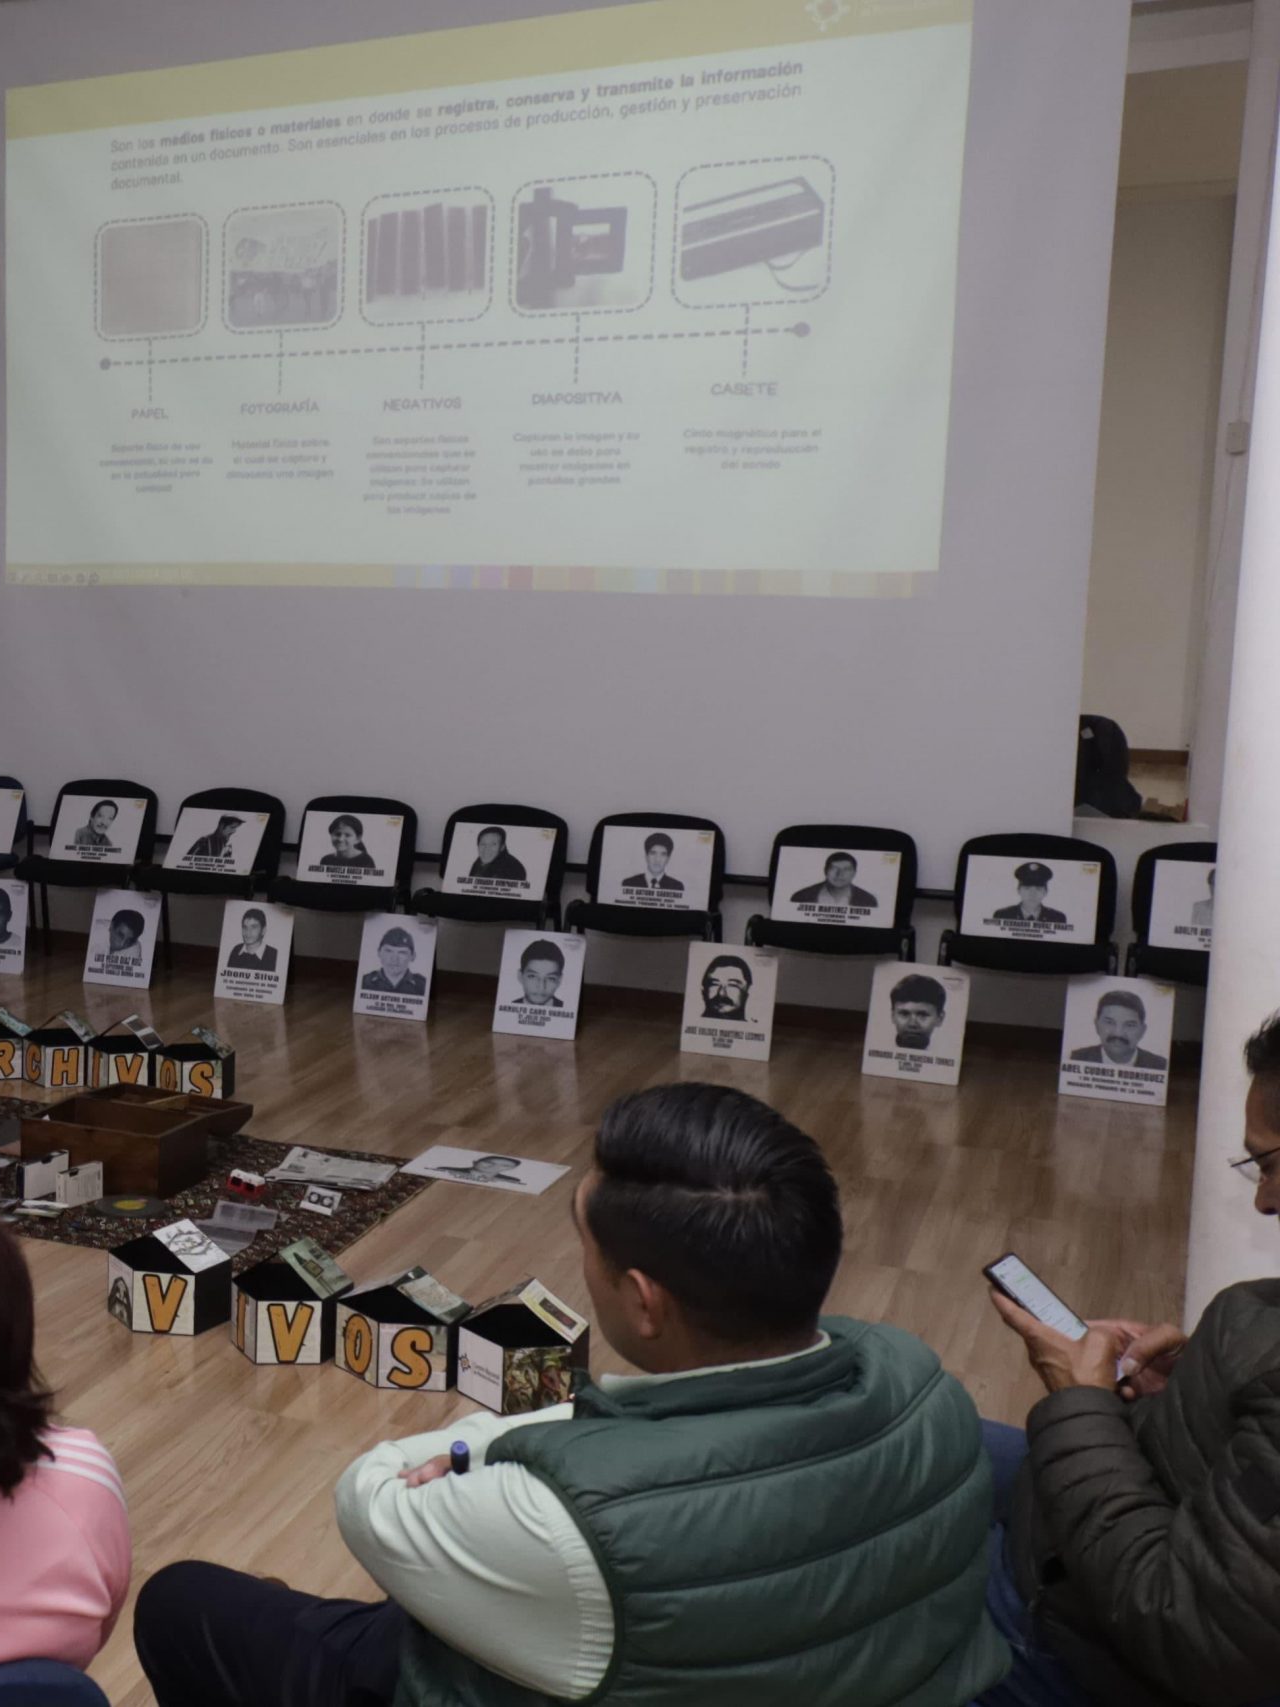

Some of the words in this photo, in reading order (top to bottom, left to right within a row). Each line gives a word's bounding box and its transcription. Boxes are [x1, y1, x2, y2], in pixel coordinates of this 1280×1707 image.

[160, 129, 205, 148] medios
[270, 115, 341, 135] materiales
[346, 113, 363, 125] en
[368, 107, 411, 124] donde
[505, 88, 575, 107] conserva
[580, 88, 590, 102] y
[596, 75, 675, 97] transmite
[680, 72, 694, 87] la
[700, 60, 803, 86] información
[190, 151, 207, 162] un
[287, 138, 313, 152] Son
[316, 129, 386, 149] esenciales
[390, 129, 407, 141] en
[411, 125, 431, 139] los
[434, 118, 500, 138] procesos
[504, 115, 521, 128] de
[619, 96, 677, 119] gestión
[681, 96, 691, 112] y
[695, 83, 802, 110] preservación
[710, 381, 779, 397] CASETE
[382, 395, 462, 412] NEGATIVOS
[531, 390, 623, 407] DIAPOSITIVA
[131, 407, 169, 420] PAPEL
